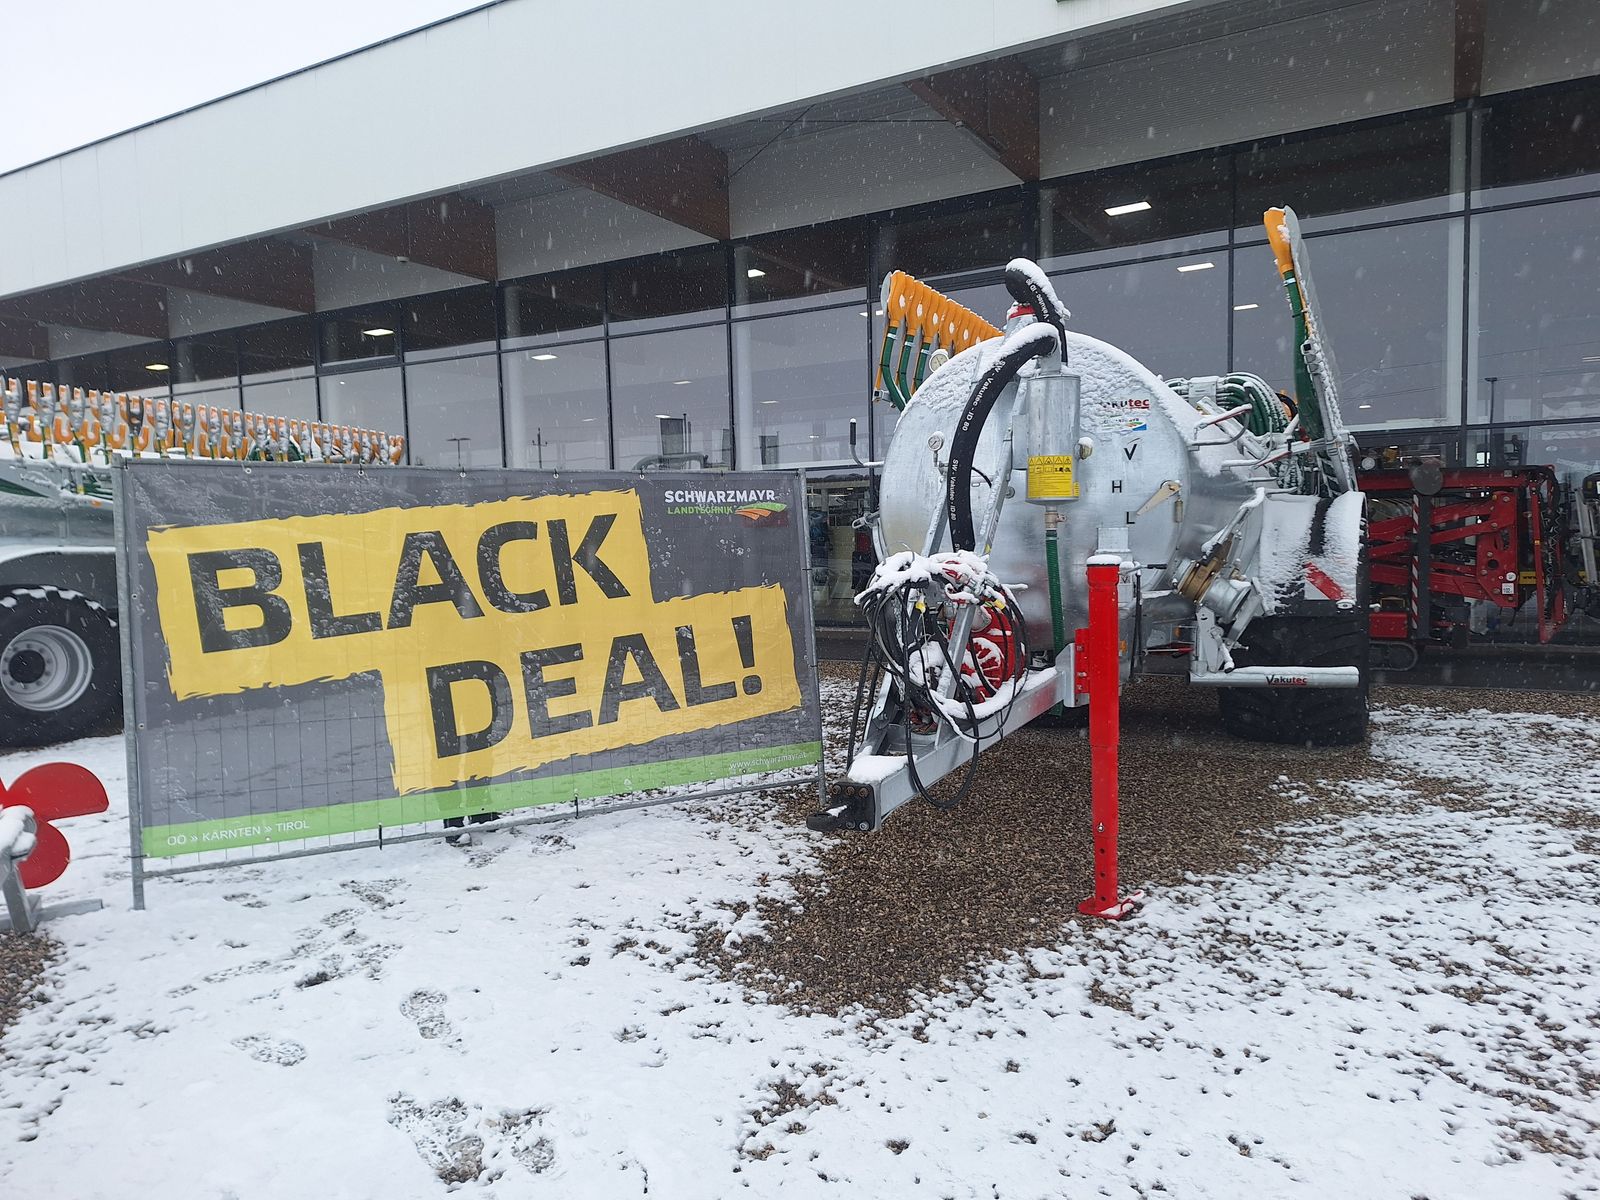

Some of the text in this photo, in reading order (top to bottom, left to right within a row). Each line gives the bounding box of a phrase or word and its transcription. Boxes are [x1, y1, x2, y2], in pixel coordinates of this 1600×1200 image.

[973, 377, 994, 406] Vakutec
[966, 411, 974, 421] ID
[962, 421, 970, 431] 80
[1124, 443, 1137, 460] V
[951, 459, 959, 472] SW
[1112, 480, 1122, 493] H
[664, 489, 776, 503] SCHWARZMAYR
[667, 505, 733, 515] LANDTECHNIK
[1126, 511, 1135, 525] L
[187, 513, 631, 654] BLACK
[1266, 674, 1308, 685] Vakutec
[425, 615, 763, 759] DEAL!
[729, 752, 807, 769] www.schwarzmayr.at
[275, 820, 310, 832] TIROL
